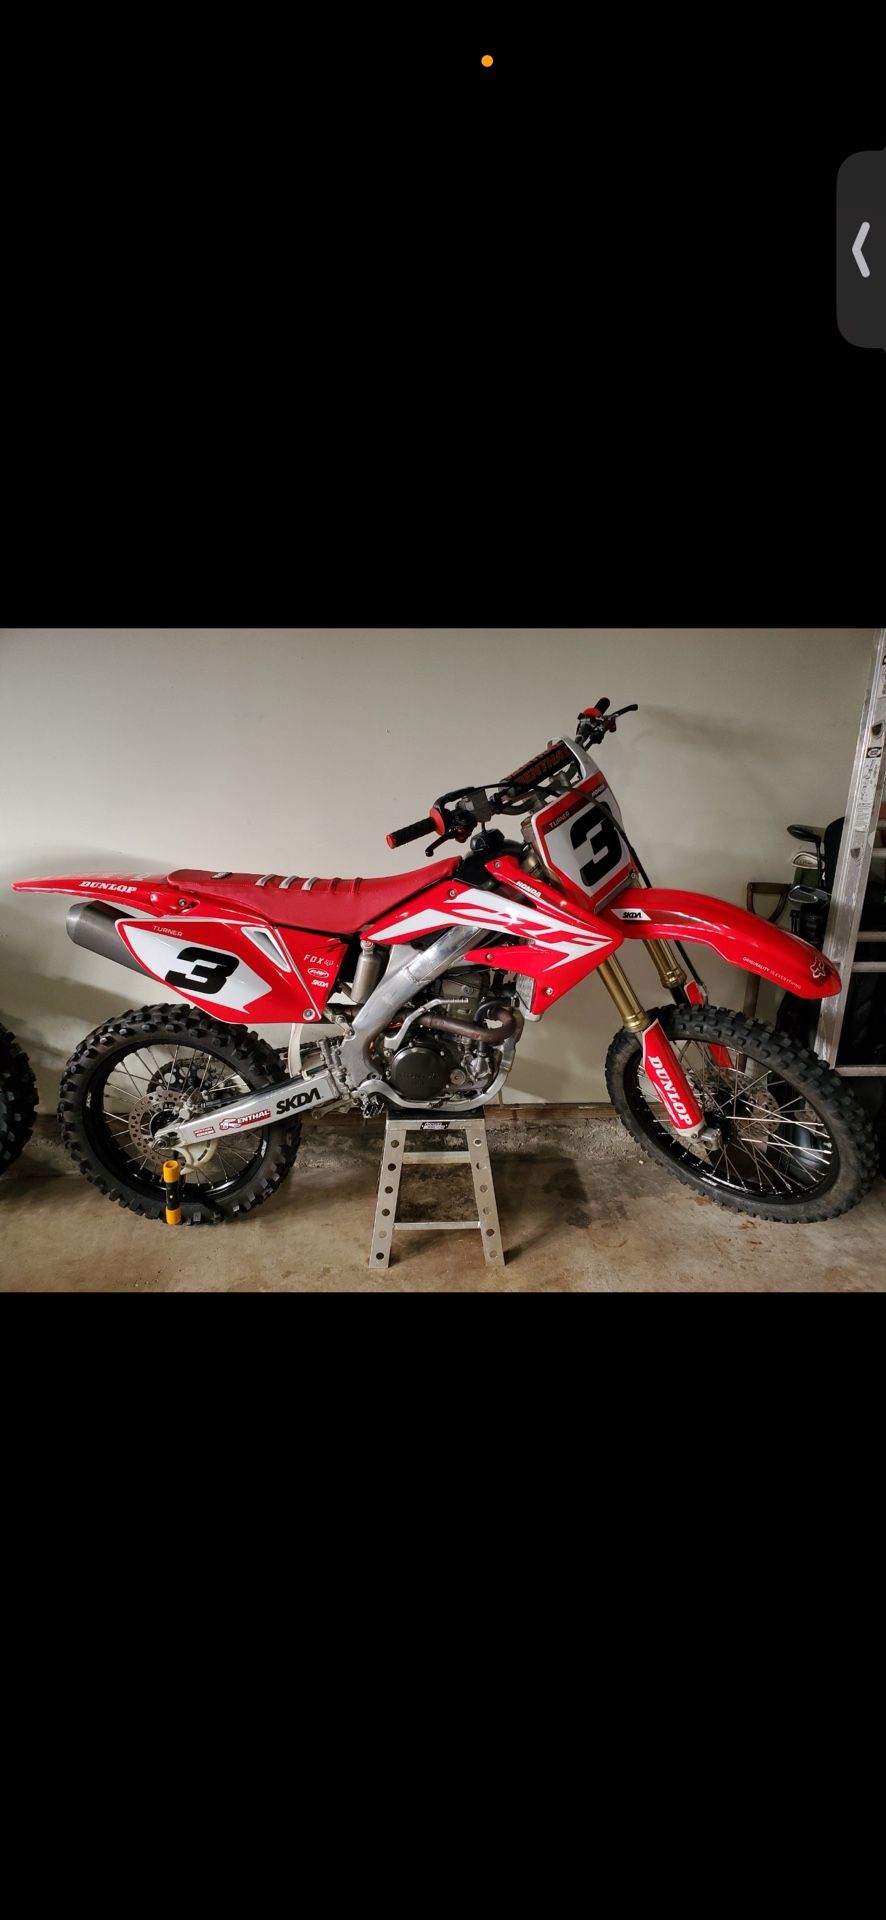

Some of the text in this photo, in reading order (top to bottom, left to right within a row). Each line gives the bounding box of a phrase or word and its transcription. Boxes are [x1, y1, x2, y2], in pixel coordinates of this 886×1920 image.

[549, 812, 570, 828] TURNER
[570, 801, 622, 887] 3
[79, 880, 138, 894] DUNLOP
[515, 880, 542, 898] HONDA
[153, 925, 183, 937] TURNER
[303, 954, 324, 965] FOX
[742, 956, 770, 972] ORIGINALITY
[165, 946, 240, 995] 3
[648, 1056, 693, 1125] DUNLOP
[276, 1087, 321, 1115] SKDA
